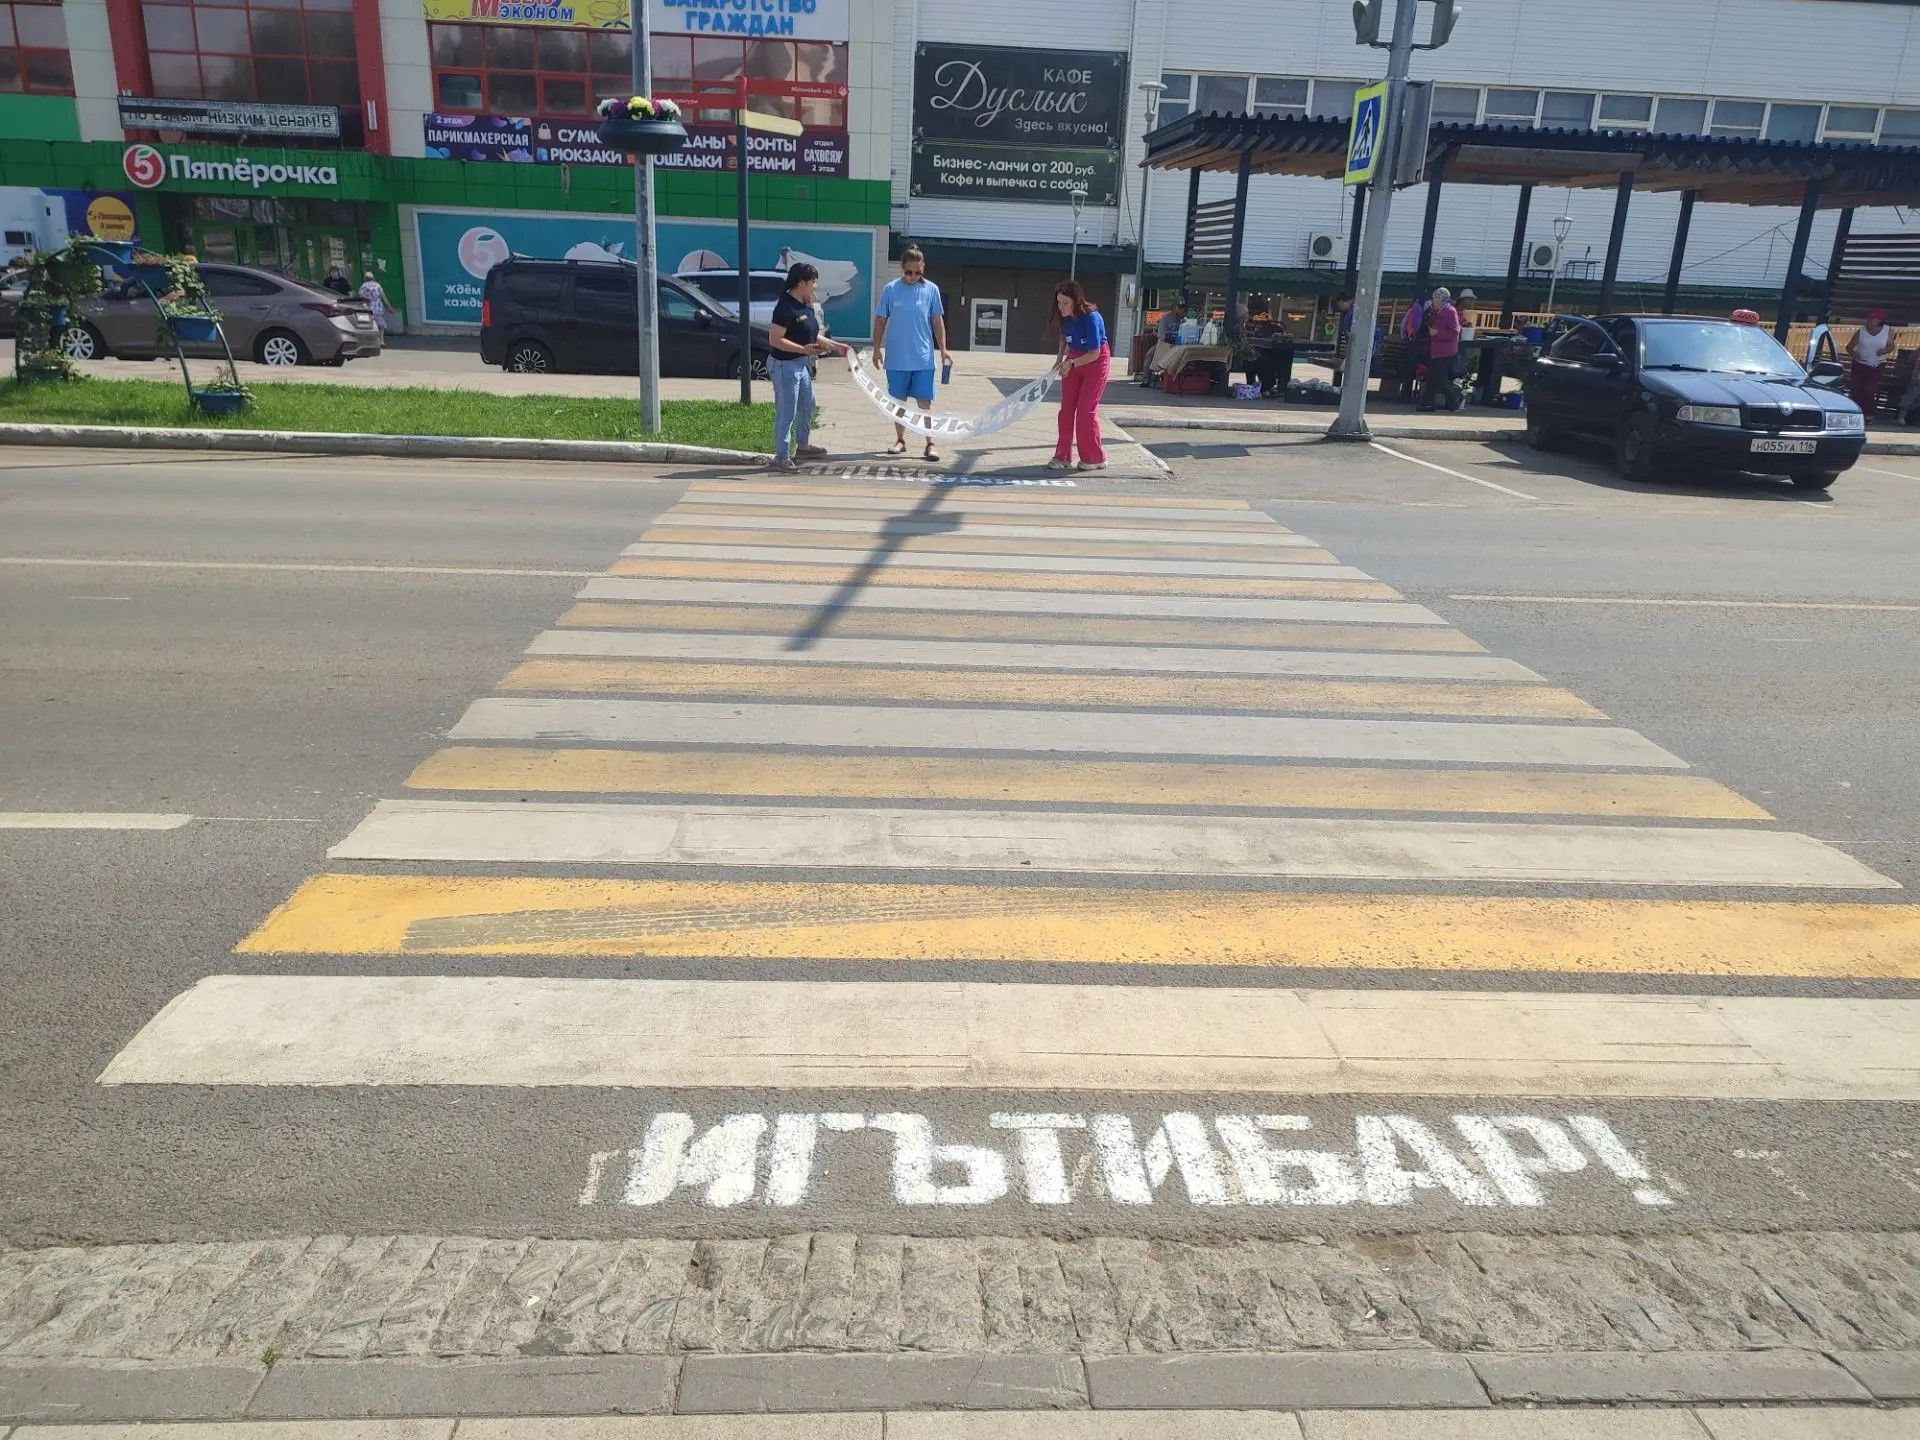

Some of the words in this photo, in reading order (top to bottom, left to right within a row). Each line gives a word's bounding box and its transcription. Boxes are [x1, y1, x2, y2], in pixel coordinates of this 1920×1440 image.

[500, 5, 574, 21] ЭКОНОМ
[686, 11, 794, 37] ГРАЖДАН
[1044, 68, 1092, 84] КАФЕ
[930, 60, 1088, 128] Дуслык
[207, 111, 264, 126] низким
[436, 115, 442, 124] 2
[1015, 117, 1054, 133] Здесь
[1058, 121, 1108, 135] вкусно!
[428, 129, 529, 147] ПАРИКМАХЕРСКАЯ
[558, 128, 603, 144] СУМК
[746, 135, 797, 153] ЗОНТЫ
[550, 147, 622, 164] РЮКЗАКИ
[654, 153, 723, 169] ОШЕЛЬКИ
[746, 156, 796, 172] РЕМНИ
[812, 164, 817, 172] 2
[818, 165, 836, 173] этаж
[933, 154, 1029, 173] Бизнес-ланчи
[1031, 163, 1048, 174] от
[1050, 161, 1074, 175] 200
[1075, 165, 1097, 176] руб.
[170, 154, 338, 188] Пятёрочка
[940, 173, 973, 187] Кофе
[976, 177, 984, 186] и
[986, 178, 1037, 189] выпечка
[1039, 180, 1046, 189] с
[1050, 178, 1088, 191] собой
[444, 283, 481, 295] Ждём
[624, 1111, 1674, 1208] ИГЪТИБАР!
